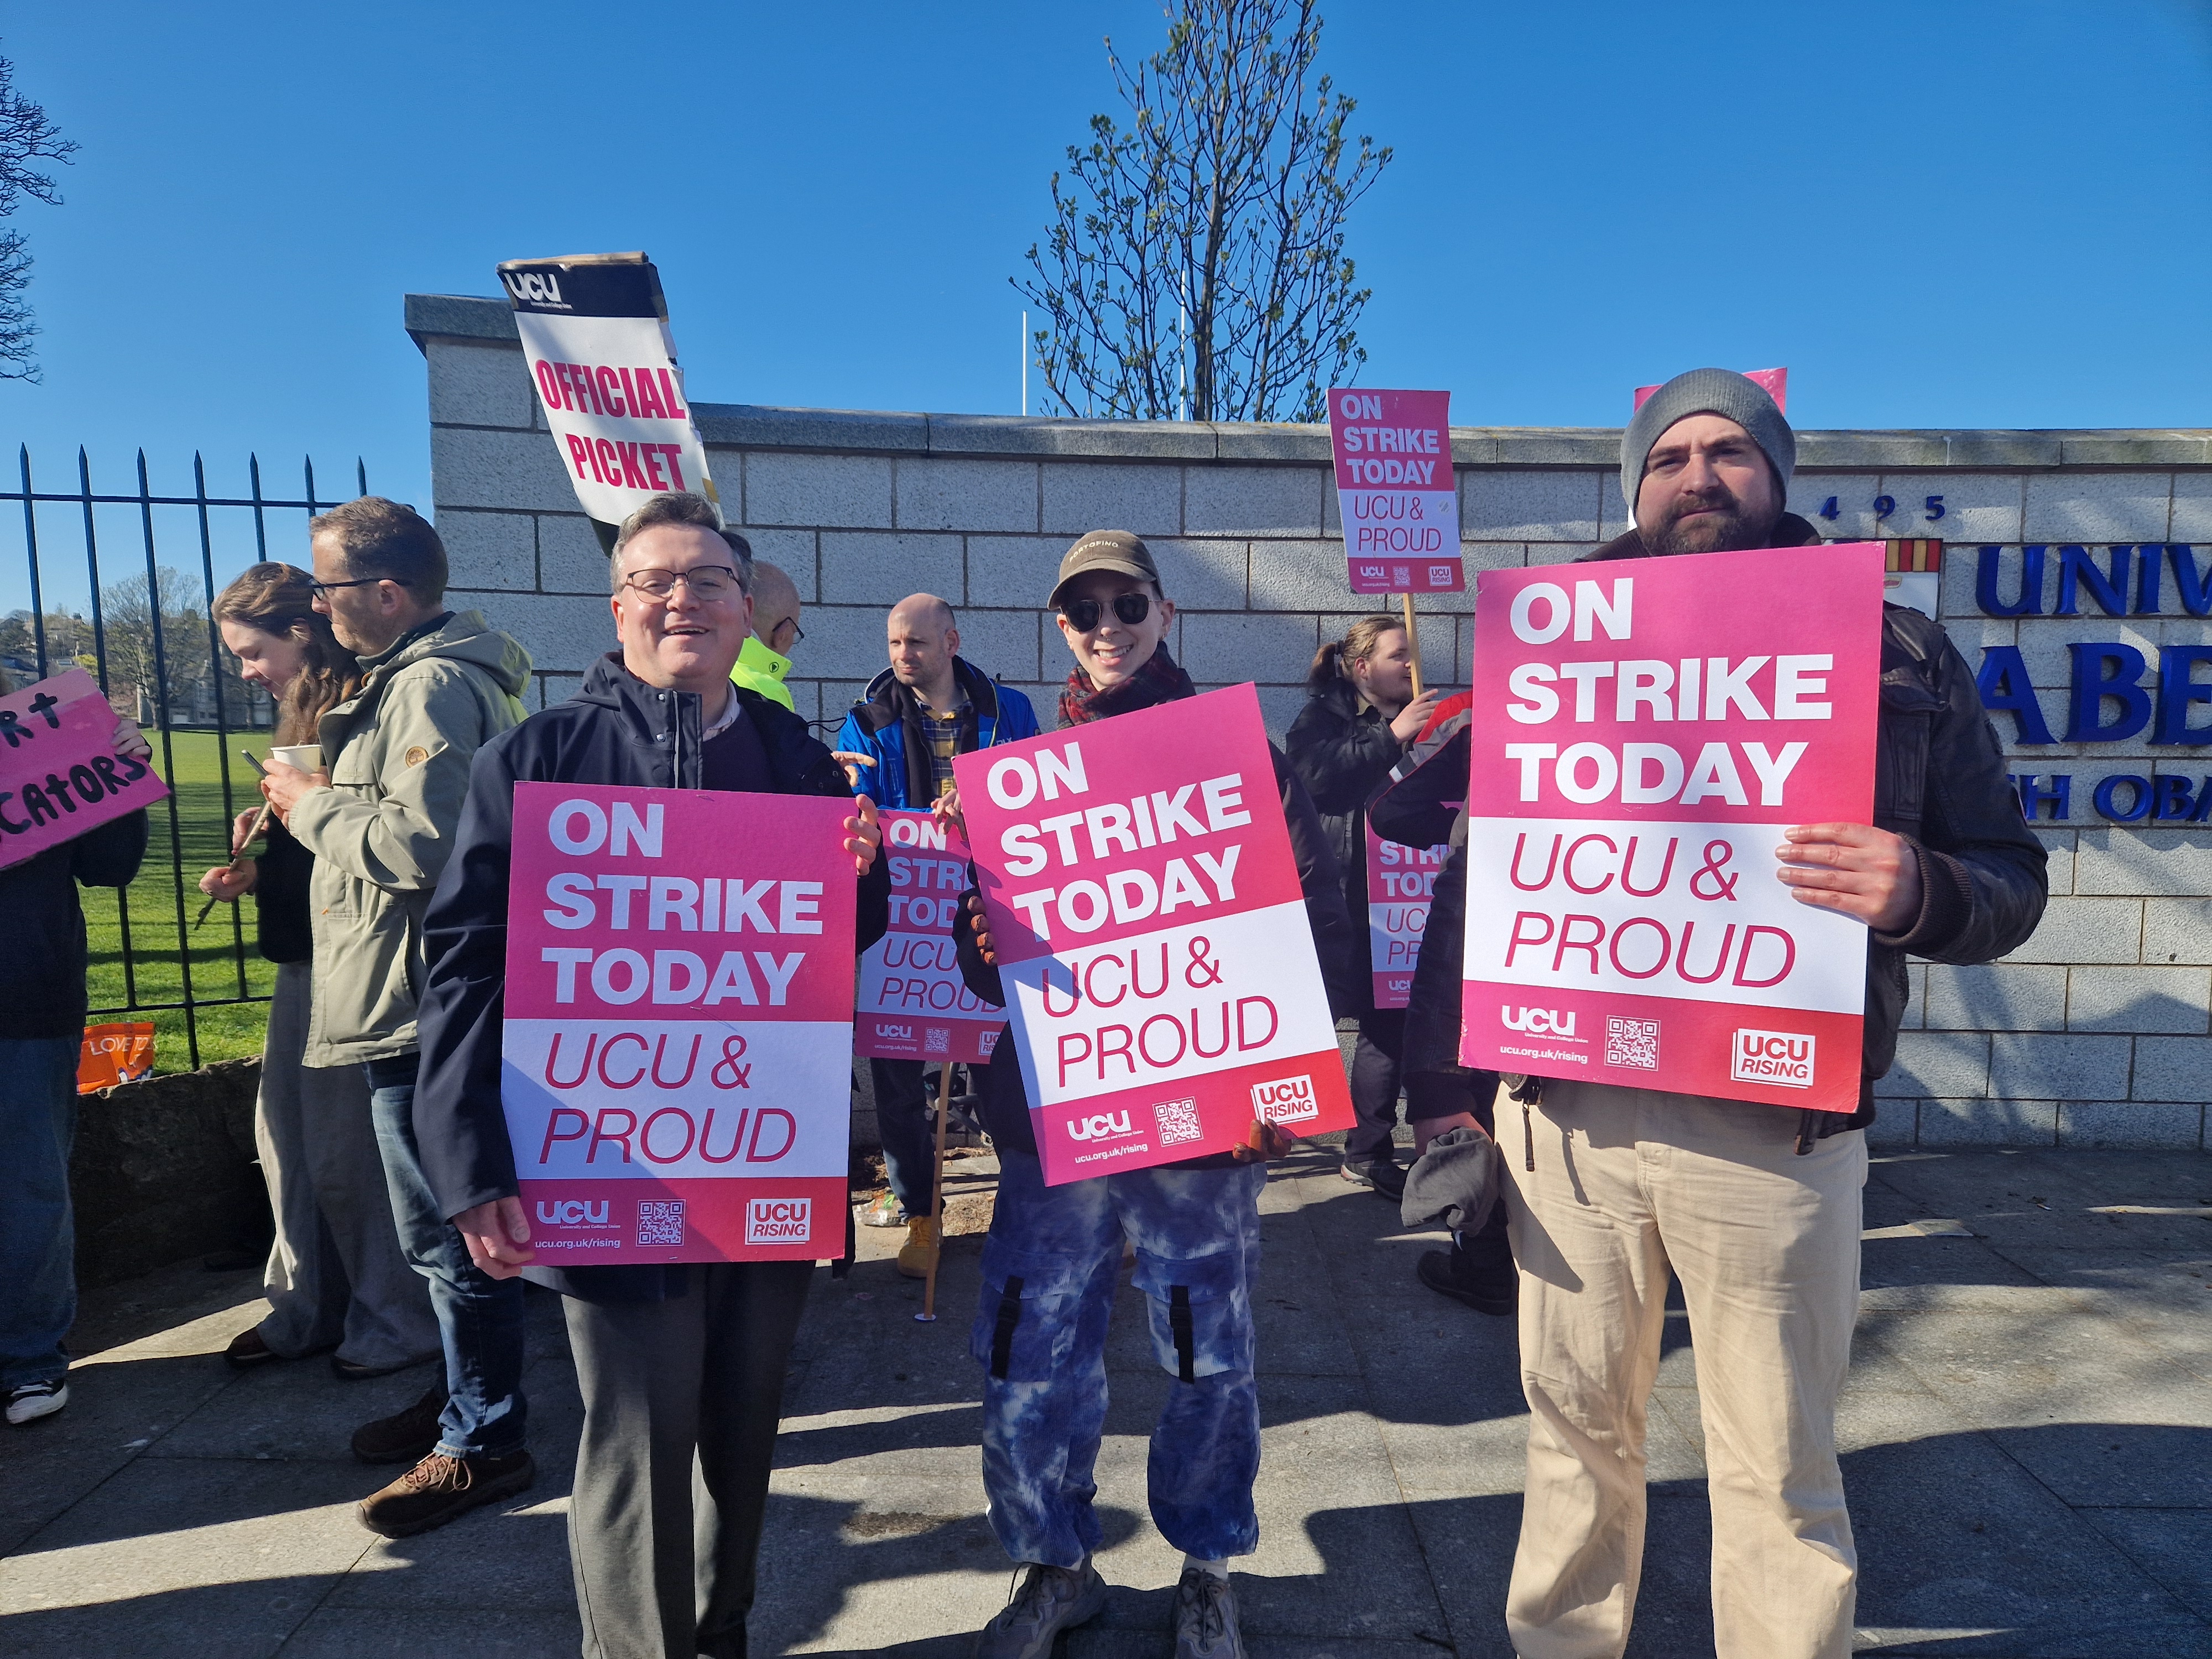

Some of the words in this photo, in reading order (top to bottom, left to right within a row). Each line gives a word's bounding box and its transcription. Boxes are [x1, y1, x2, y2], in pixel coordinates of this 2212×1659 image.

[535, 359, 686, 419] OFFICIAL
[1340, 394, 1381, 420] ON
[1343, 426, 1439, 454] STRIKE
[565, 433, 686, 492] PICKET
[1346, 459, 1435, 484] TODAY
[1354, 495, 1405, 520] UCU
[1410, 497, 1423, 520] &
[1069, 540, 1119, 562] PORTOFINO
[1358, 527, 1441, 552] PROUD
[1510, 577, 1634, 645] ON
[1506, 654, 1833, 724] STRIKE
[987, 741, 1089, 810] ON
[1505, 741, 1809, 806] TODAY
[548, 799, 664, 857] ON
[890, 819, 946, 851] ON
[1000, 773, 1251, 877] STRIKE
[1510, 833, 1678, 898] UCU
[1689, 839, 1739, 901] &
[543, 872, 823, 934] STRIKE
[1012, 844, 1241, 942] TODAY
[1504, 911, 1796, 988] PROUD
[541, 947, 806, 1005] TODAY
[1042, 942, 1168, 1018] UCU
[1185, 936, 1223, 989] &
[90, 1037, 133, 1056] LOVE
[545, 1032, 702, 1089] UCU
[711, 1035, 752, 1089] &
[1057, 995, 1279, 1087] PROUD
[1500, 1046, 1588, 1064] ucu.org.uk/rising
[1743, 1035, 1808, 1062] UCU
[1741, 1058, 1808, 1079] RISING
[1259, 1080, 1308, 1104] UCU
[1264, 1099, 1313, 1118] RISING
[538, 1107, 796, 1164] PROUD
[1074, 1143, 1148, 1164] ucu.org.uk/rising
[753, 1224, 806, 1236] RISING
[754, 1203, 806, 1222] UCU
[535, 1238, 620, 1250] ucu.org.uk/rising
